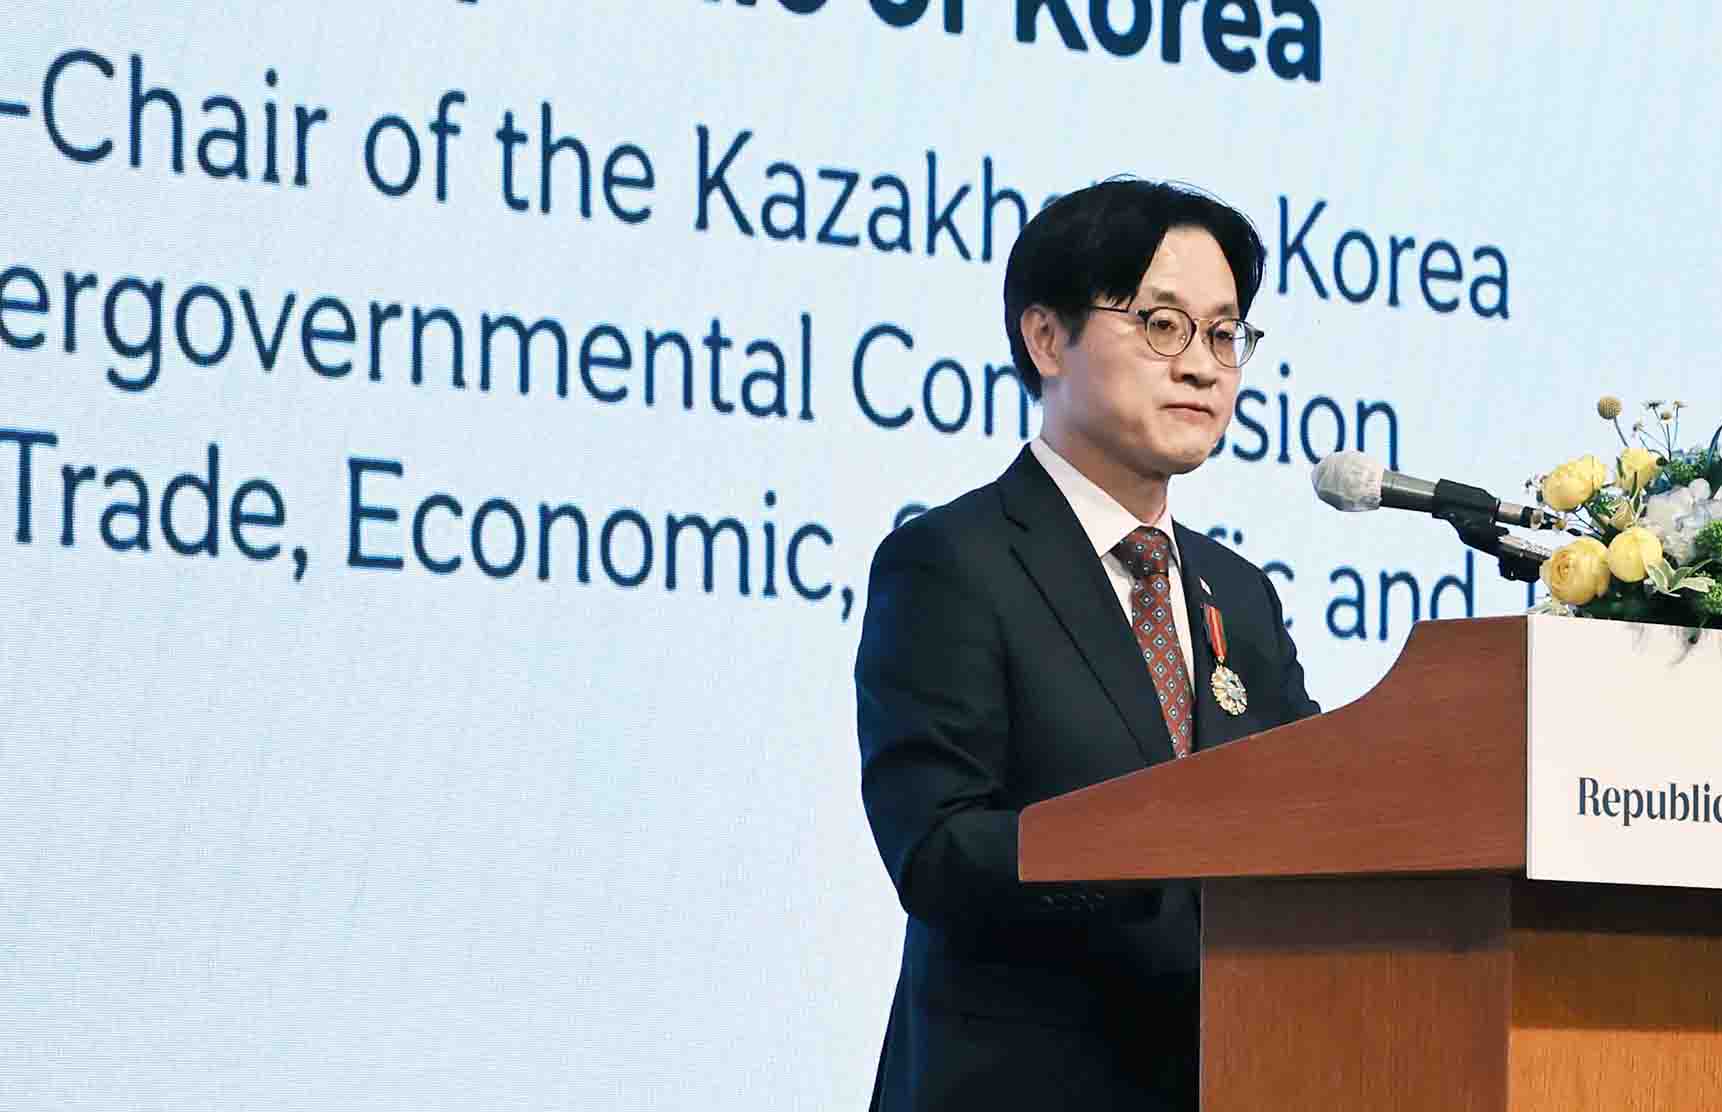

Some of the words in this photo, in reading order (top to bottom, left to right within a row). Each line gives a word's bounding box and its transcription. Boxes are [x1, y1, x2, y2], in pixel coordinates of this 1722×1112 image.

[363, 89, 467, 204] of
[495, 100, 656, 226] the
[0, 264, 815, 422] ergovernmental
[0, 426, 309, 583] Trade,
[346, 455, 855, 623] Economic,
[1325, 548, 1475, 641] and
